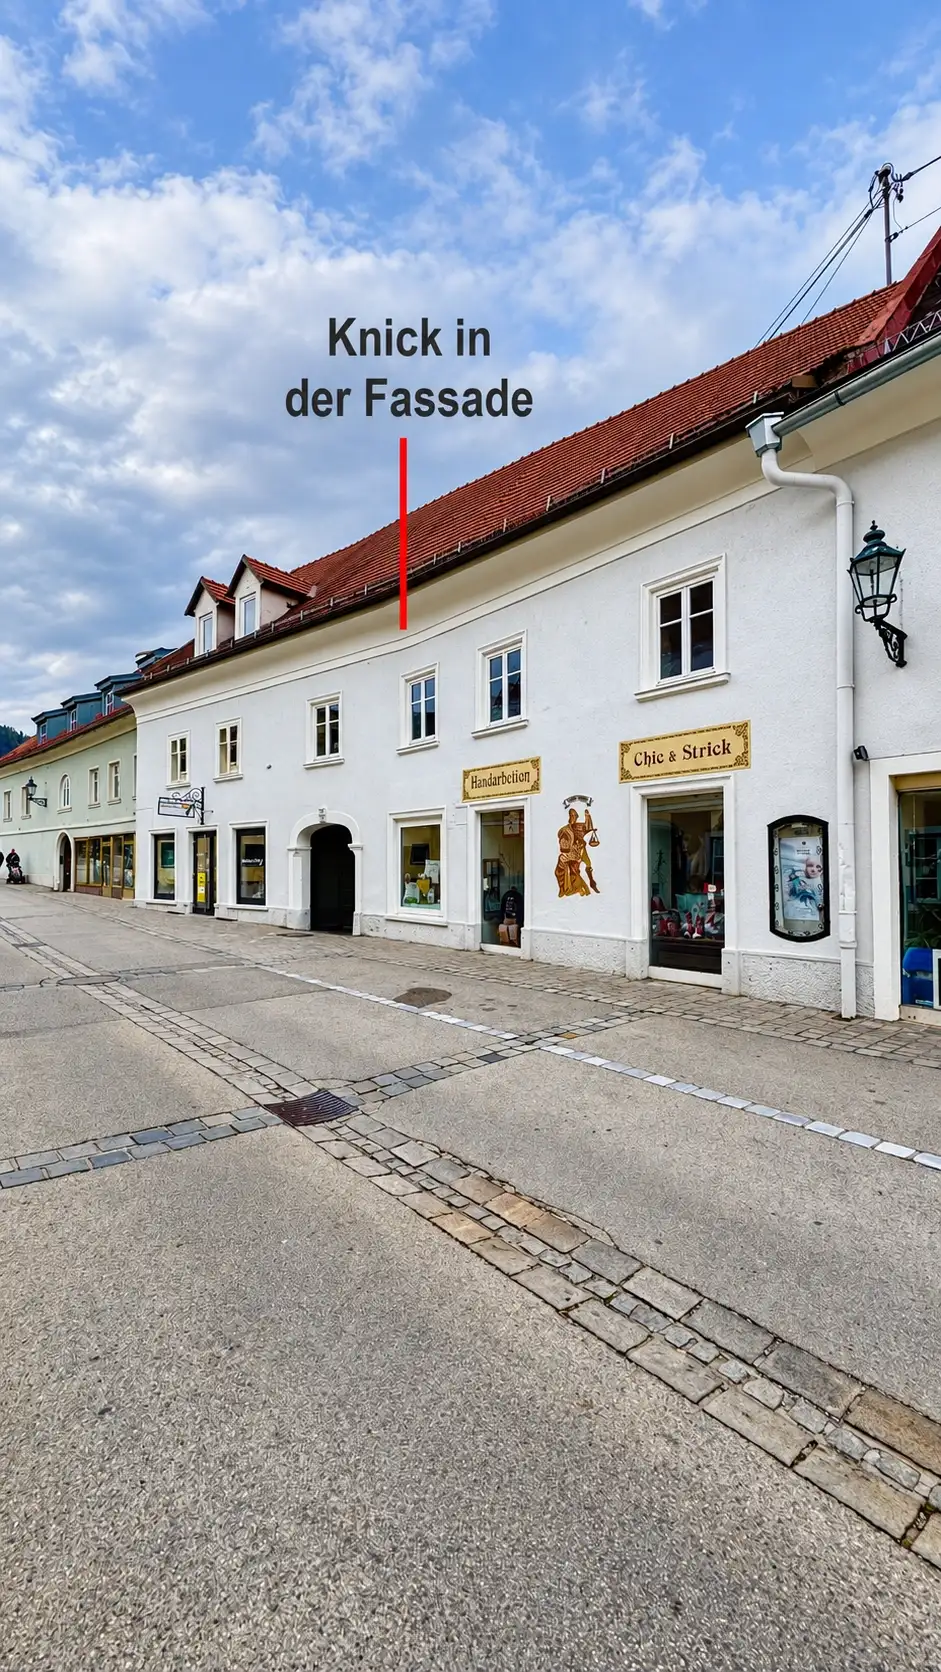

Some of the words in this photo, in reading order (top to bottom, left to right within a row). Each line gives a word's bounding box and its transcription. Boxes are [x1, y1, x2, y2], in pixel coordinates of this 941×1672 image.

[634, 750, 664, 767] Chic
[668, 750, 677, 762] &
[682, 739, 732, 760] Strick
